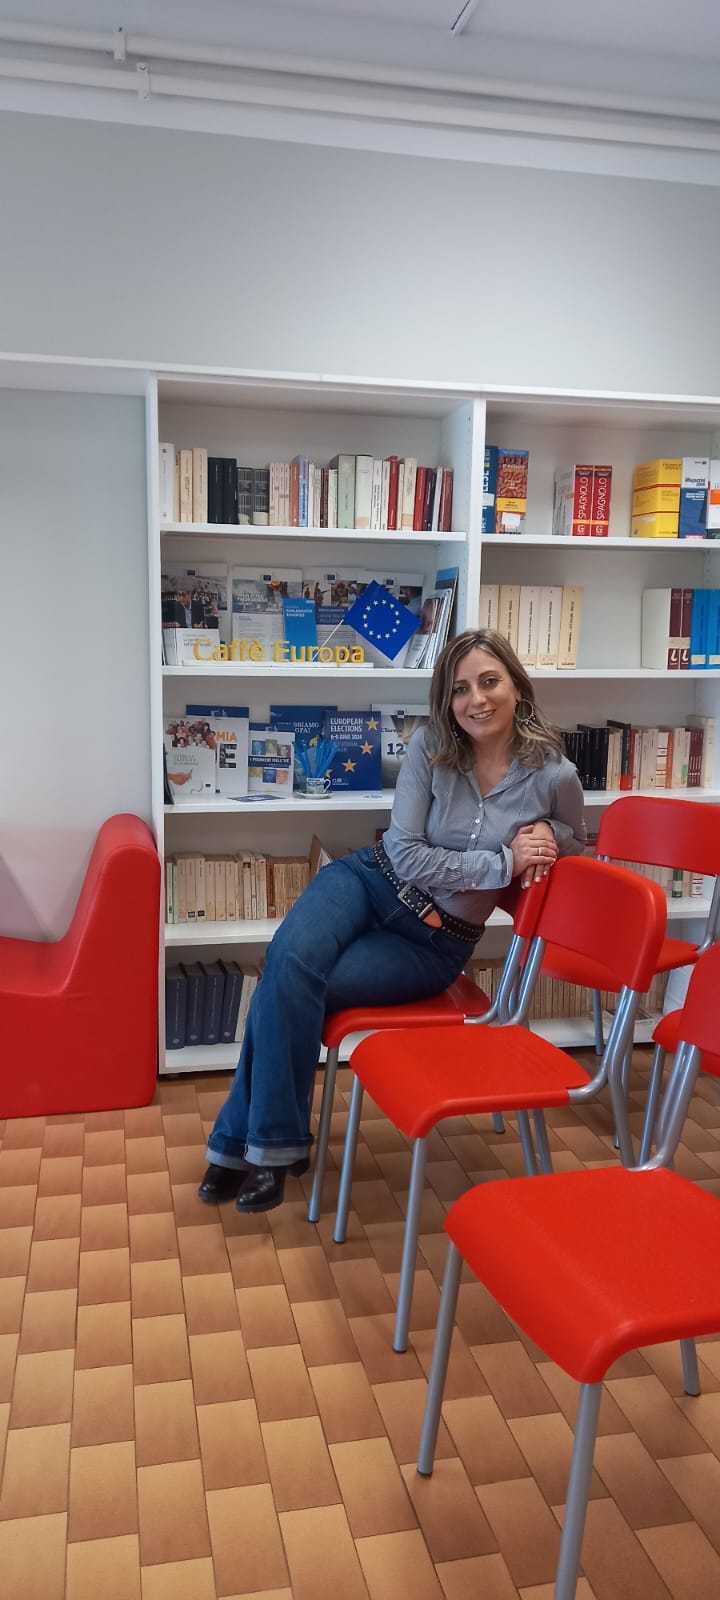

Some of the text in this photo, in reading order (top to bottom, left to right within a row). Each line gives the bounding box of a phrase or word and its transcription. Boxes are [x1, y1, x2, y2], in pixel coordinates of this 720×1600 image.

[578, 477, 589, 519] SPAGNOLO
[597, 478, 607, 520] SPAGNOLO
[193, 638, 265, 662] Caffè
[273, 640, 365, 667] Europa
[330, 717, 363, 725] EUROPEAN
[330, 725, 363, 733] ELECTIONS
[216, 731, 238, 742] MIA
